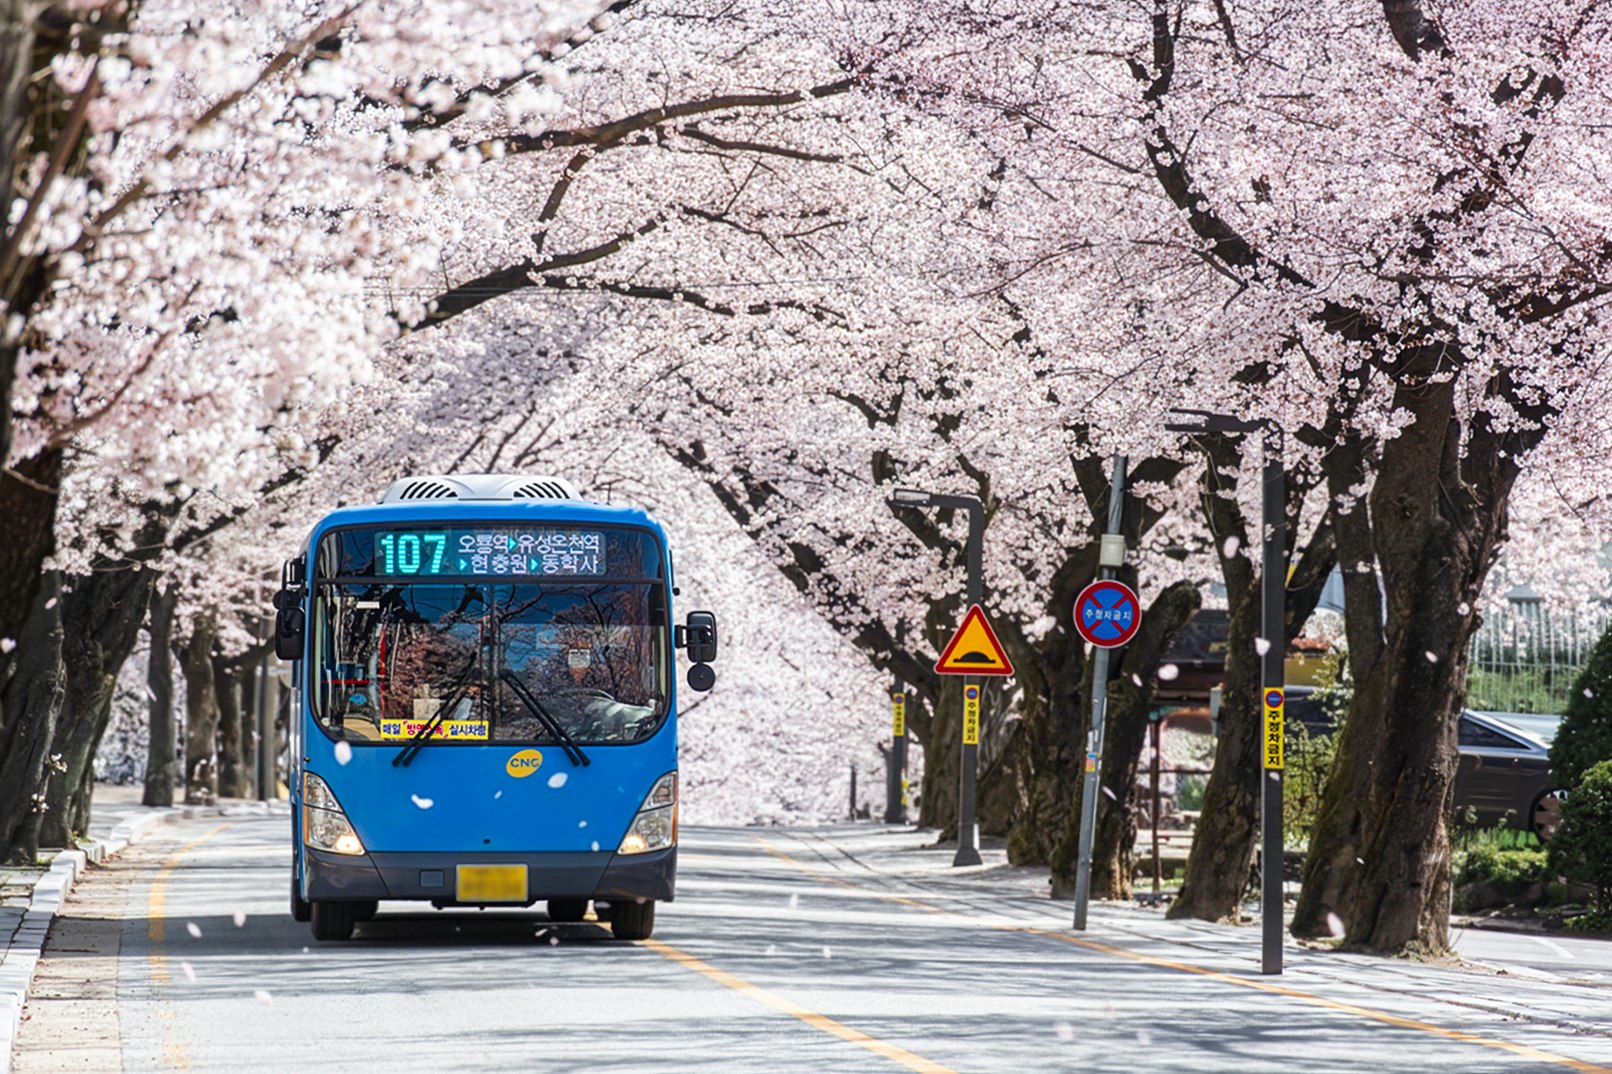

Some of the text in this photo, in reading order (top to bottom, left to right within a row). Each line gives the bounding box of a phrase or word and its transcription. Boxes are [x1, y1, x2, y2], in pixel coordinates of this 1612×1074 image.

[380, 534, 446, 574] 107
[457, 534, 600, 554] 오룡역 유성온천역
[471, 554, 599, 574] 현충원 동학사
[1085, 609, 1132, 621] 주정차금지
[382, 723, 401, 735] 매일
[449, 724, 487, 736] 실시차량
[1268, 710, 1281, 766] 주정차금지
[510, 757, 541, 768] CNG
